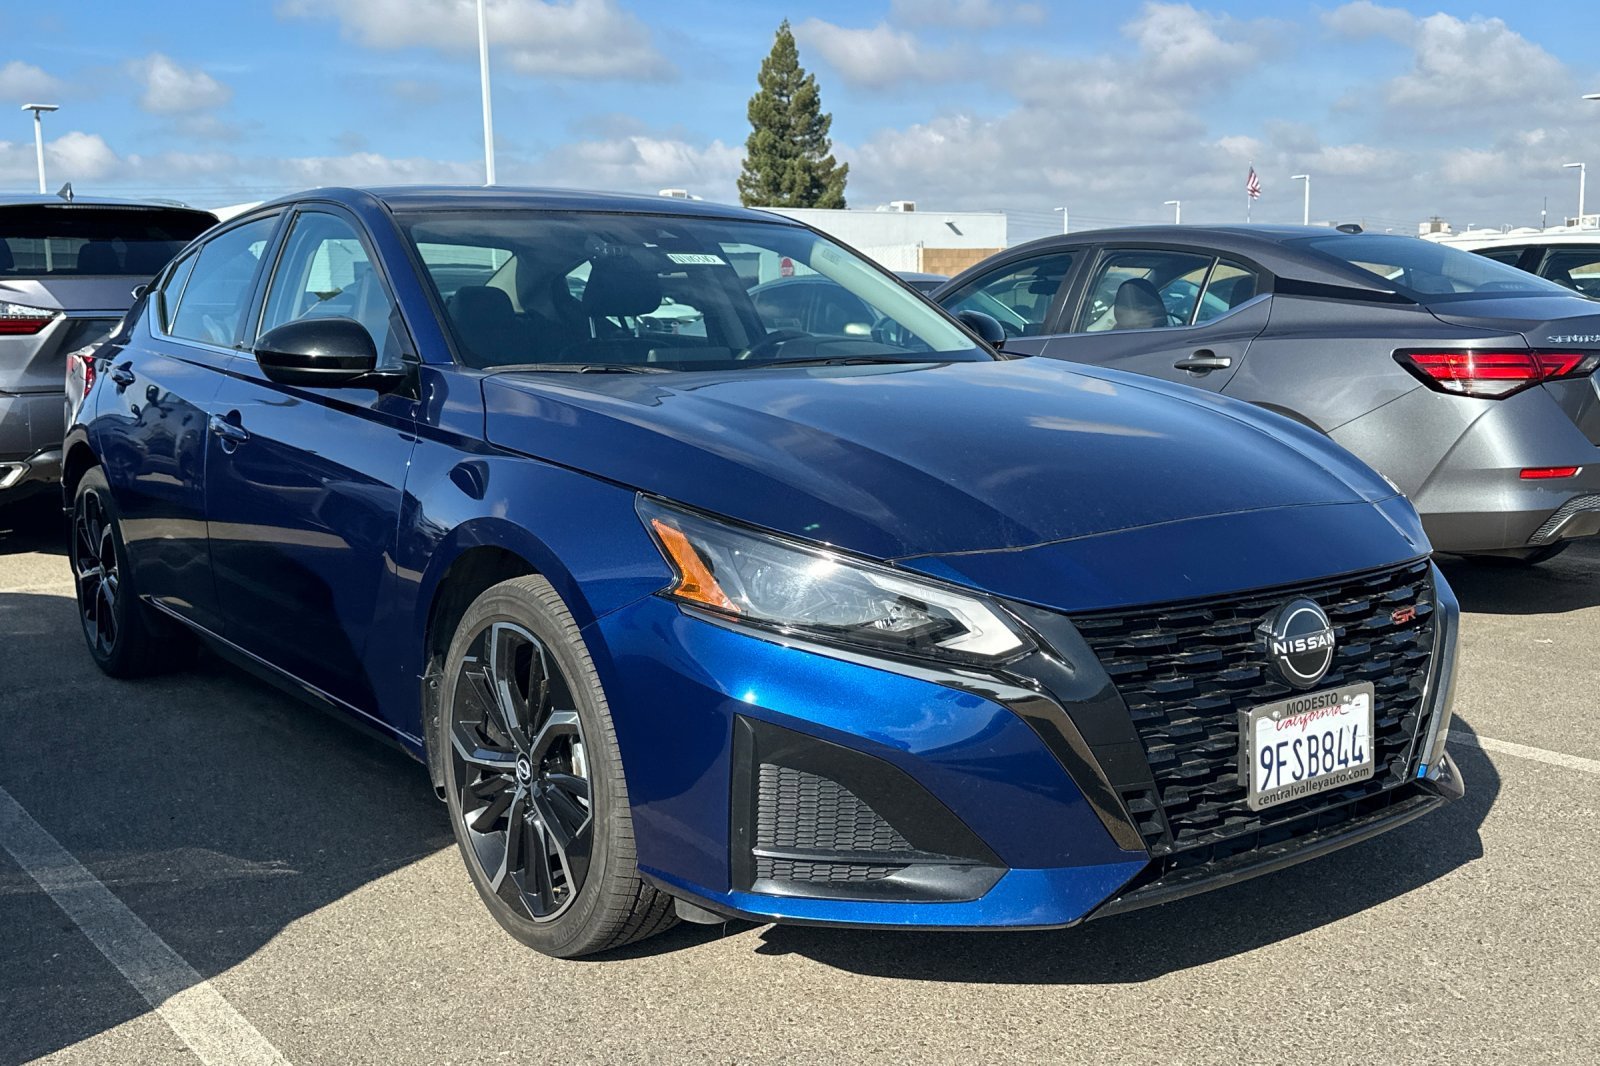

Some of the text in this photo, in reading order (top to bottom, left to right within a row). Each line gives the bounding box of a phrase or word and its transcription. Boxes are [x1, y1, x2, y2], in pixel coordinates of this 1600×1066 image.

[1392, 607, 1416, 625] SR
[1273, 631, 1335, 655] NISSAN
[1286, 692, 1338, 716] MODESTO
[1260, 724, 1364, 791] 9FSB844
[1258, 767, 1370, 806] centralvalleyauto.com
